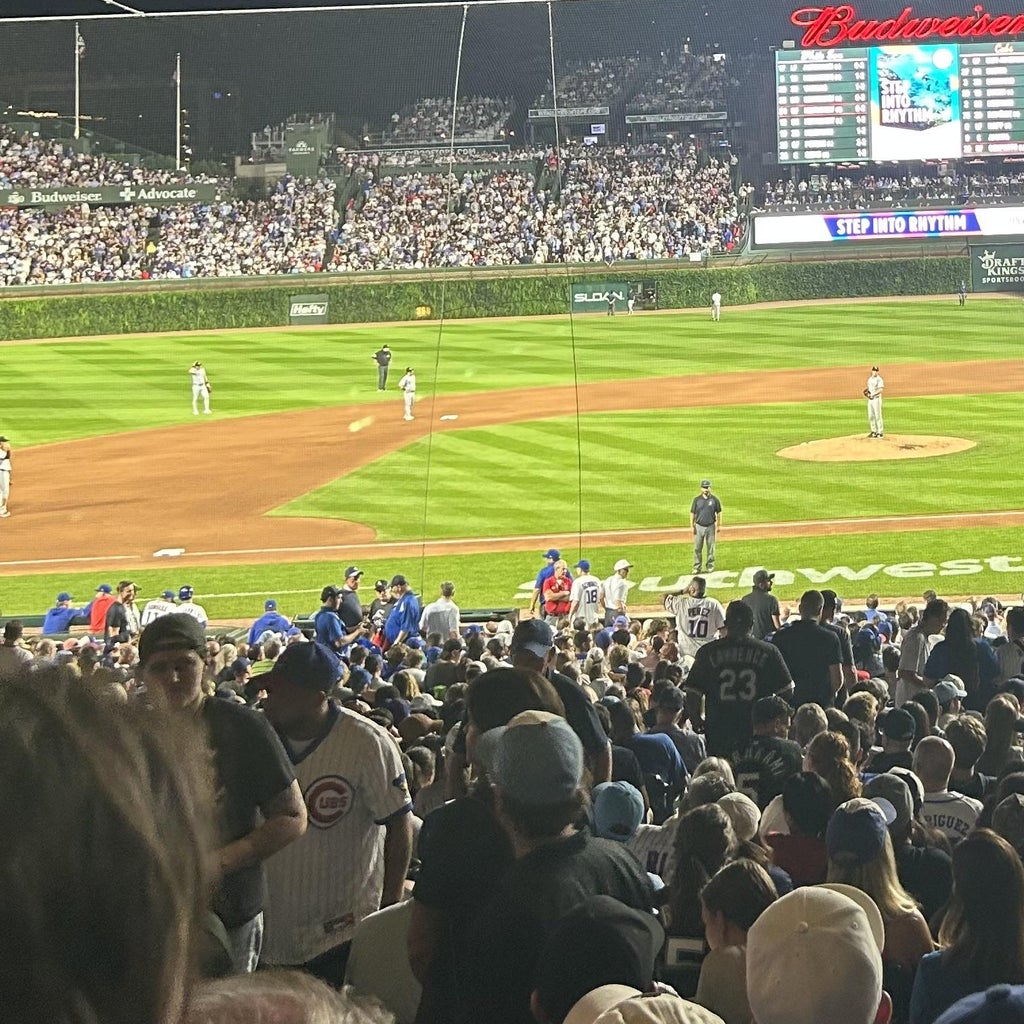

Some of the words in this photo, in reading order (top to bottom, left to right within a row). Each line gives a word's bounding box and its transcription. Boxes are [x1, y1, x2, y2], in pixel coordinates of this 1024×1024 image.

[881, 94, 911, 109] INTO
[137, 187, 196, 199] Advocate
[836, 218, 870, 235] STEP
[872, 216, 906, 234] INTO
[908, 214, 967, 232] RHYTHM
[293, 304, 325, 314] Hefty
[585, 589, 597, 604] 18
[688, 619, 709, 638] 10
[719, 669, 757, 701] 23
